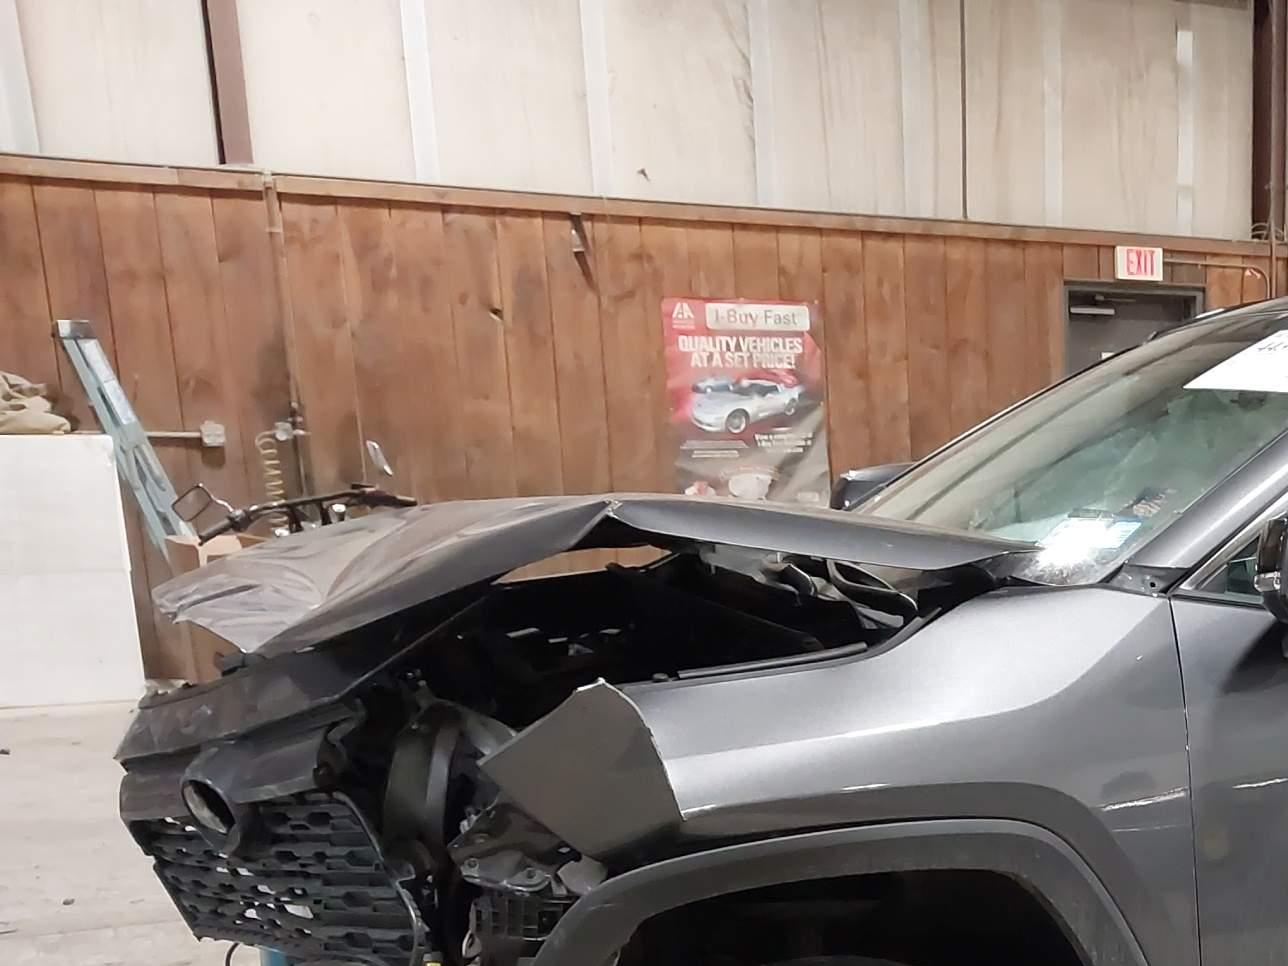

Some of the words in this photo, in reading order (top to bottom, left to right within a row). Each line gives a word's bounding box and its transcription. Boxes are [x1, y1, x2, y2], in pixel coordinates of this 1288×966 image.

[1126, 248, 1155, 277] EXIT
[763, 309, 798, 325] Fast
[678, 335, 737, 352] QUALITY
[738, 336, 803, 354] VEHICLES
[690, 352, 710, 368] AT
[711, 352, 723, 368] A
[724, 353, 750, 369] SET
